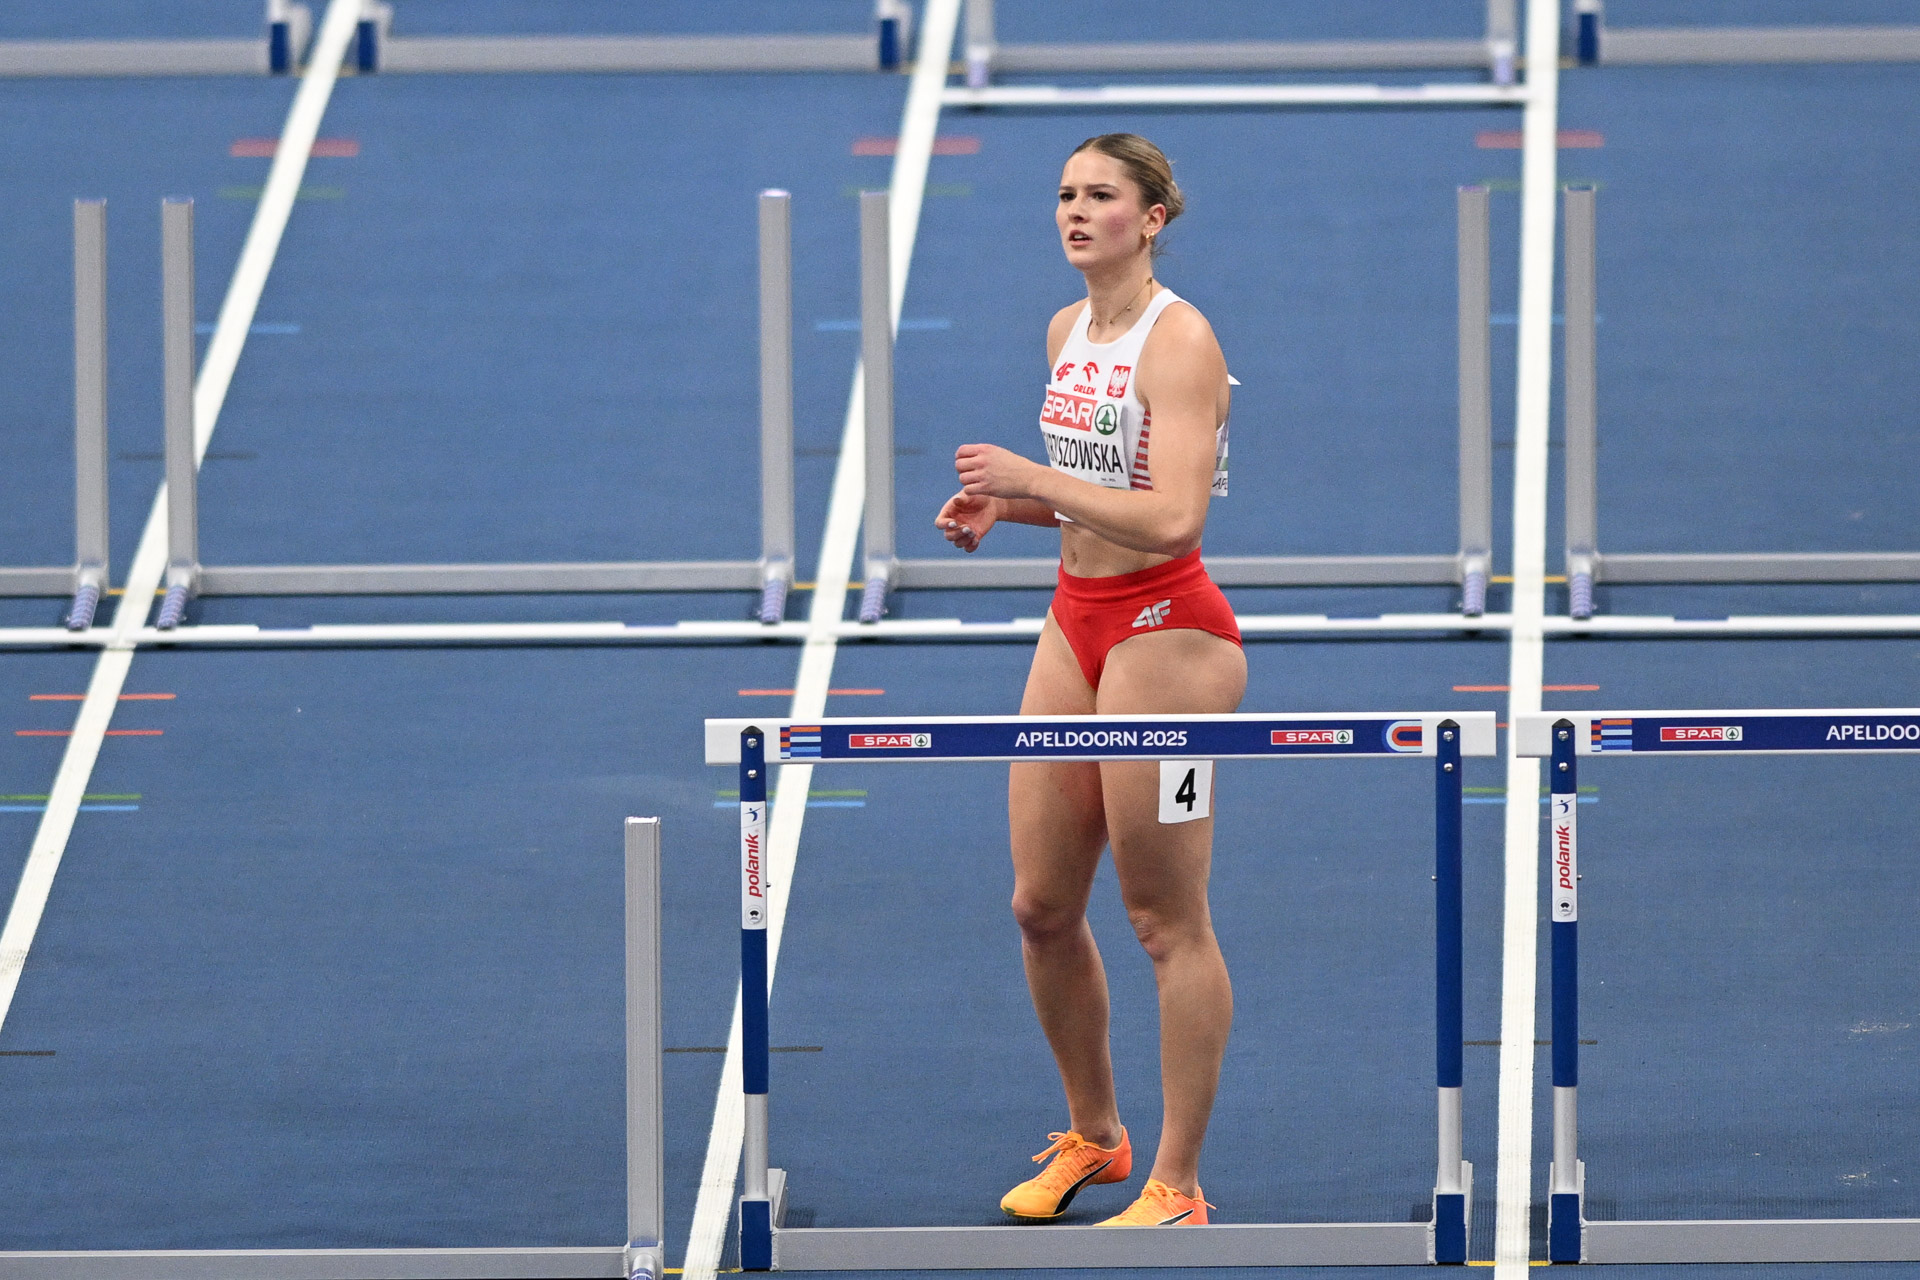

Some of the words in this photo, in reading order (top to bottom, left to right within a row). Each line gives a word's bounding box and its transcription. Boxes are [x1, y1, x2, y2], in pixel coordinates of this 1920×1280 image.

[1056, 361, 1076, 382] 4F
[1073, 383, 1097, 396] ORLEN
[1042, 394, 1094, 427] SPAR
[1131, 599, 1172, 628] 4F
[864, 736, 911, 747] SPAR
[1014, 731, 1138, 748] APELDOORN
[1142, 730, 1188, 747] 2025
[1285, 732, 1333, 743] SPAR
[1675, 728, 1722, 739] SPAR
[1175, 767, 1197, 812] 4
[744, 832, 763, 898] polanik
[1555, 824, 1574, 890] polanik
